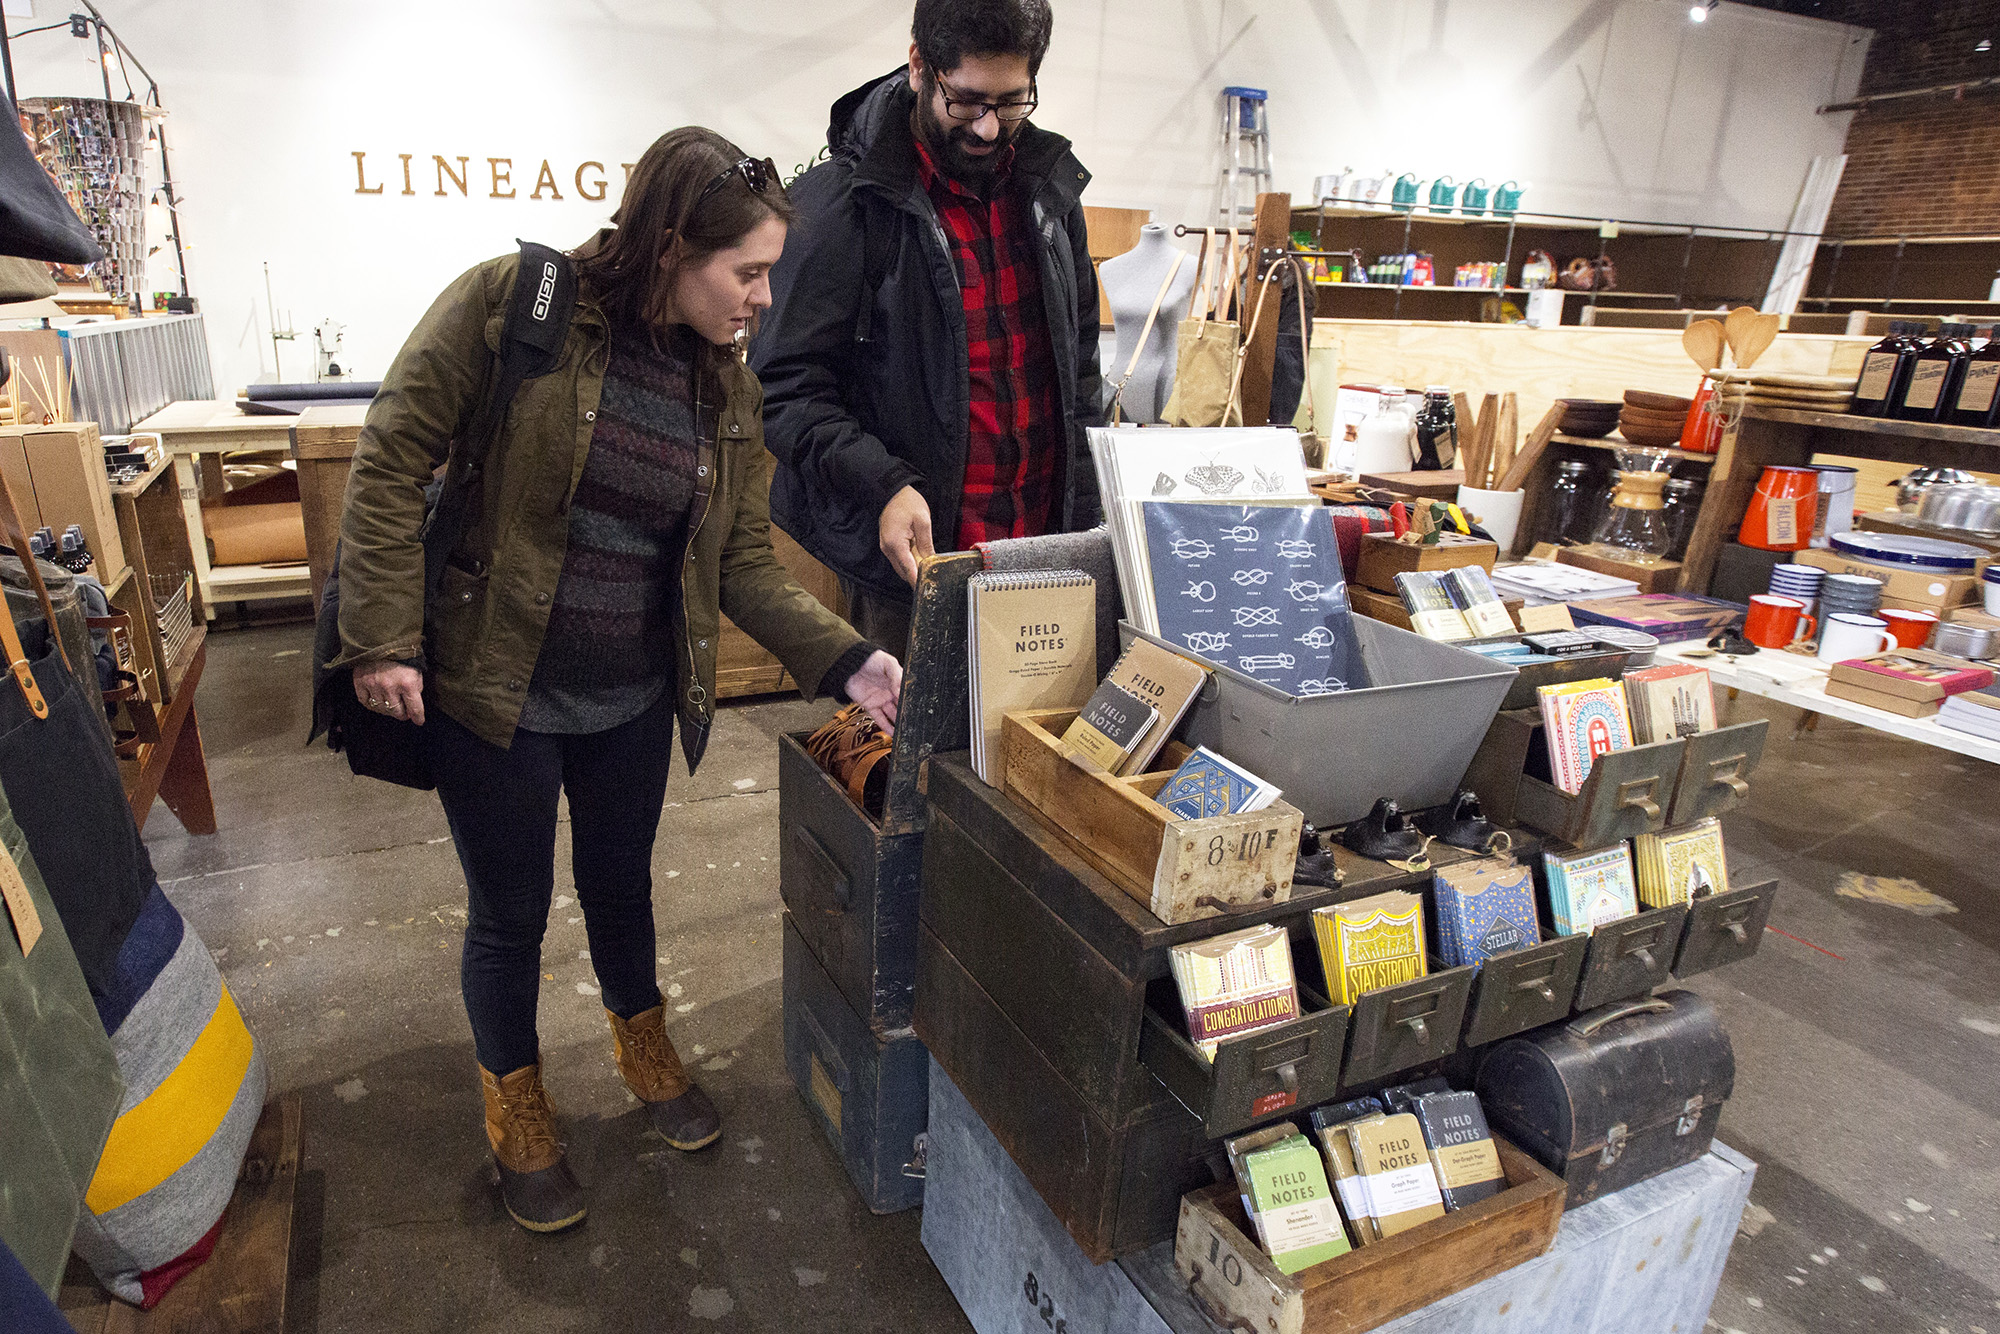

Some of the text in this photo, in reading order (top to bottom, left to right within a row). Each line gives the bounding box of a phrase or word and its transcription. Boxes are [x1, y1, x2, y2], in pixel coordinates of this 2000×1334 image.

[532, 261, 557, 320] OGIO
[1777, 503, 1792, 540] FALCON
[1421, 587, 1446, 597] FIELD
[1020, 623, 1060, 637] FIELD
[1015, 638, 1065, 653] NOTES
[1131, 673, 1165, 697] FIELD
[1100, 702, 1127, 724] FIELD
[1088, 711, 1121, 738] NOTES
[1208, 835, 1224, 866] 8
[1486, 929, 1519, 950] STELLAR
[1349, 963, 1377, 1004] STAY
[1203, 995, 1293, 1032] CONGRATULATIONS!
[1443, 1114, 1472, 1129] FIELD
[1379, 1138, 1410, 1155] FIELD
[1444, 1128, 1480, 1145] NOTES
[1379, 1153, 1418, 1171] NOTES
[1272, 1171, 1306, 1188] FIELD
[1271, 1186, 1315, 1205] NOTES
[1205, 1233, 1242, 1286] 10
